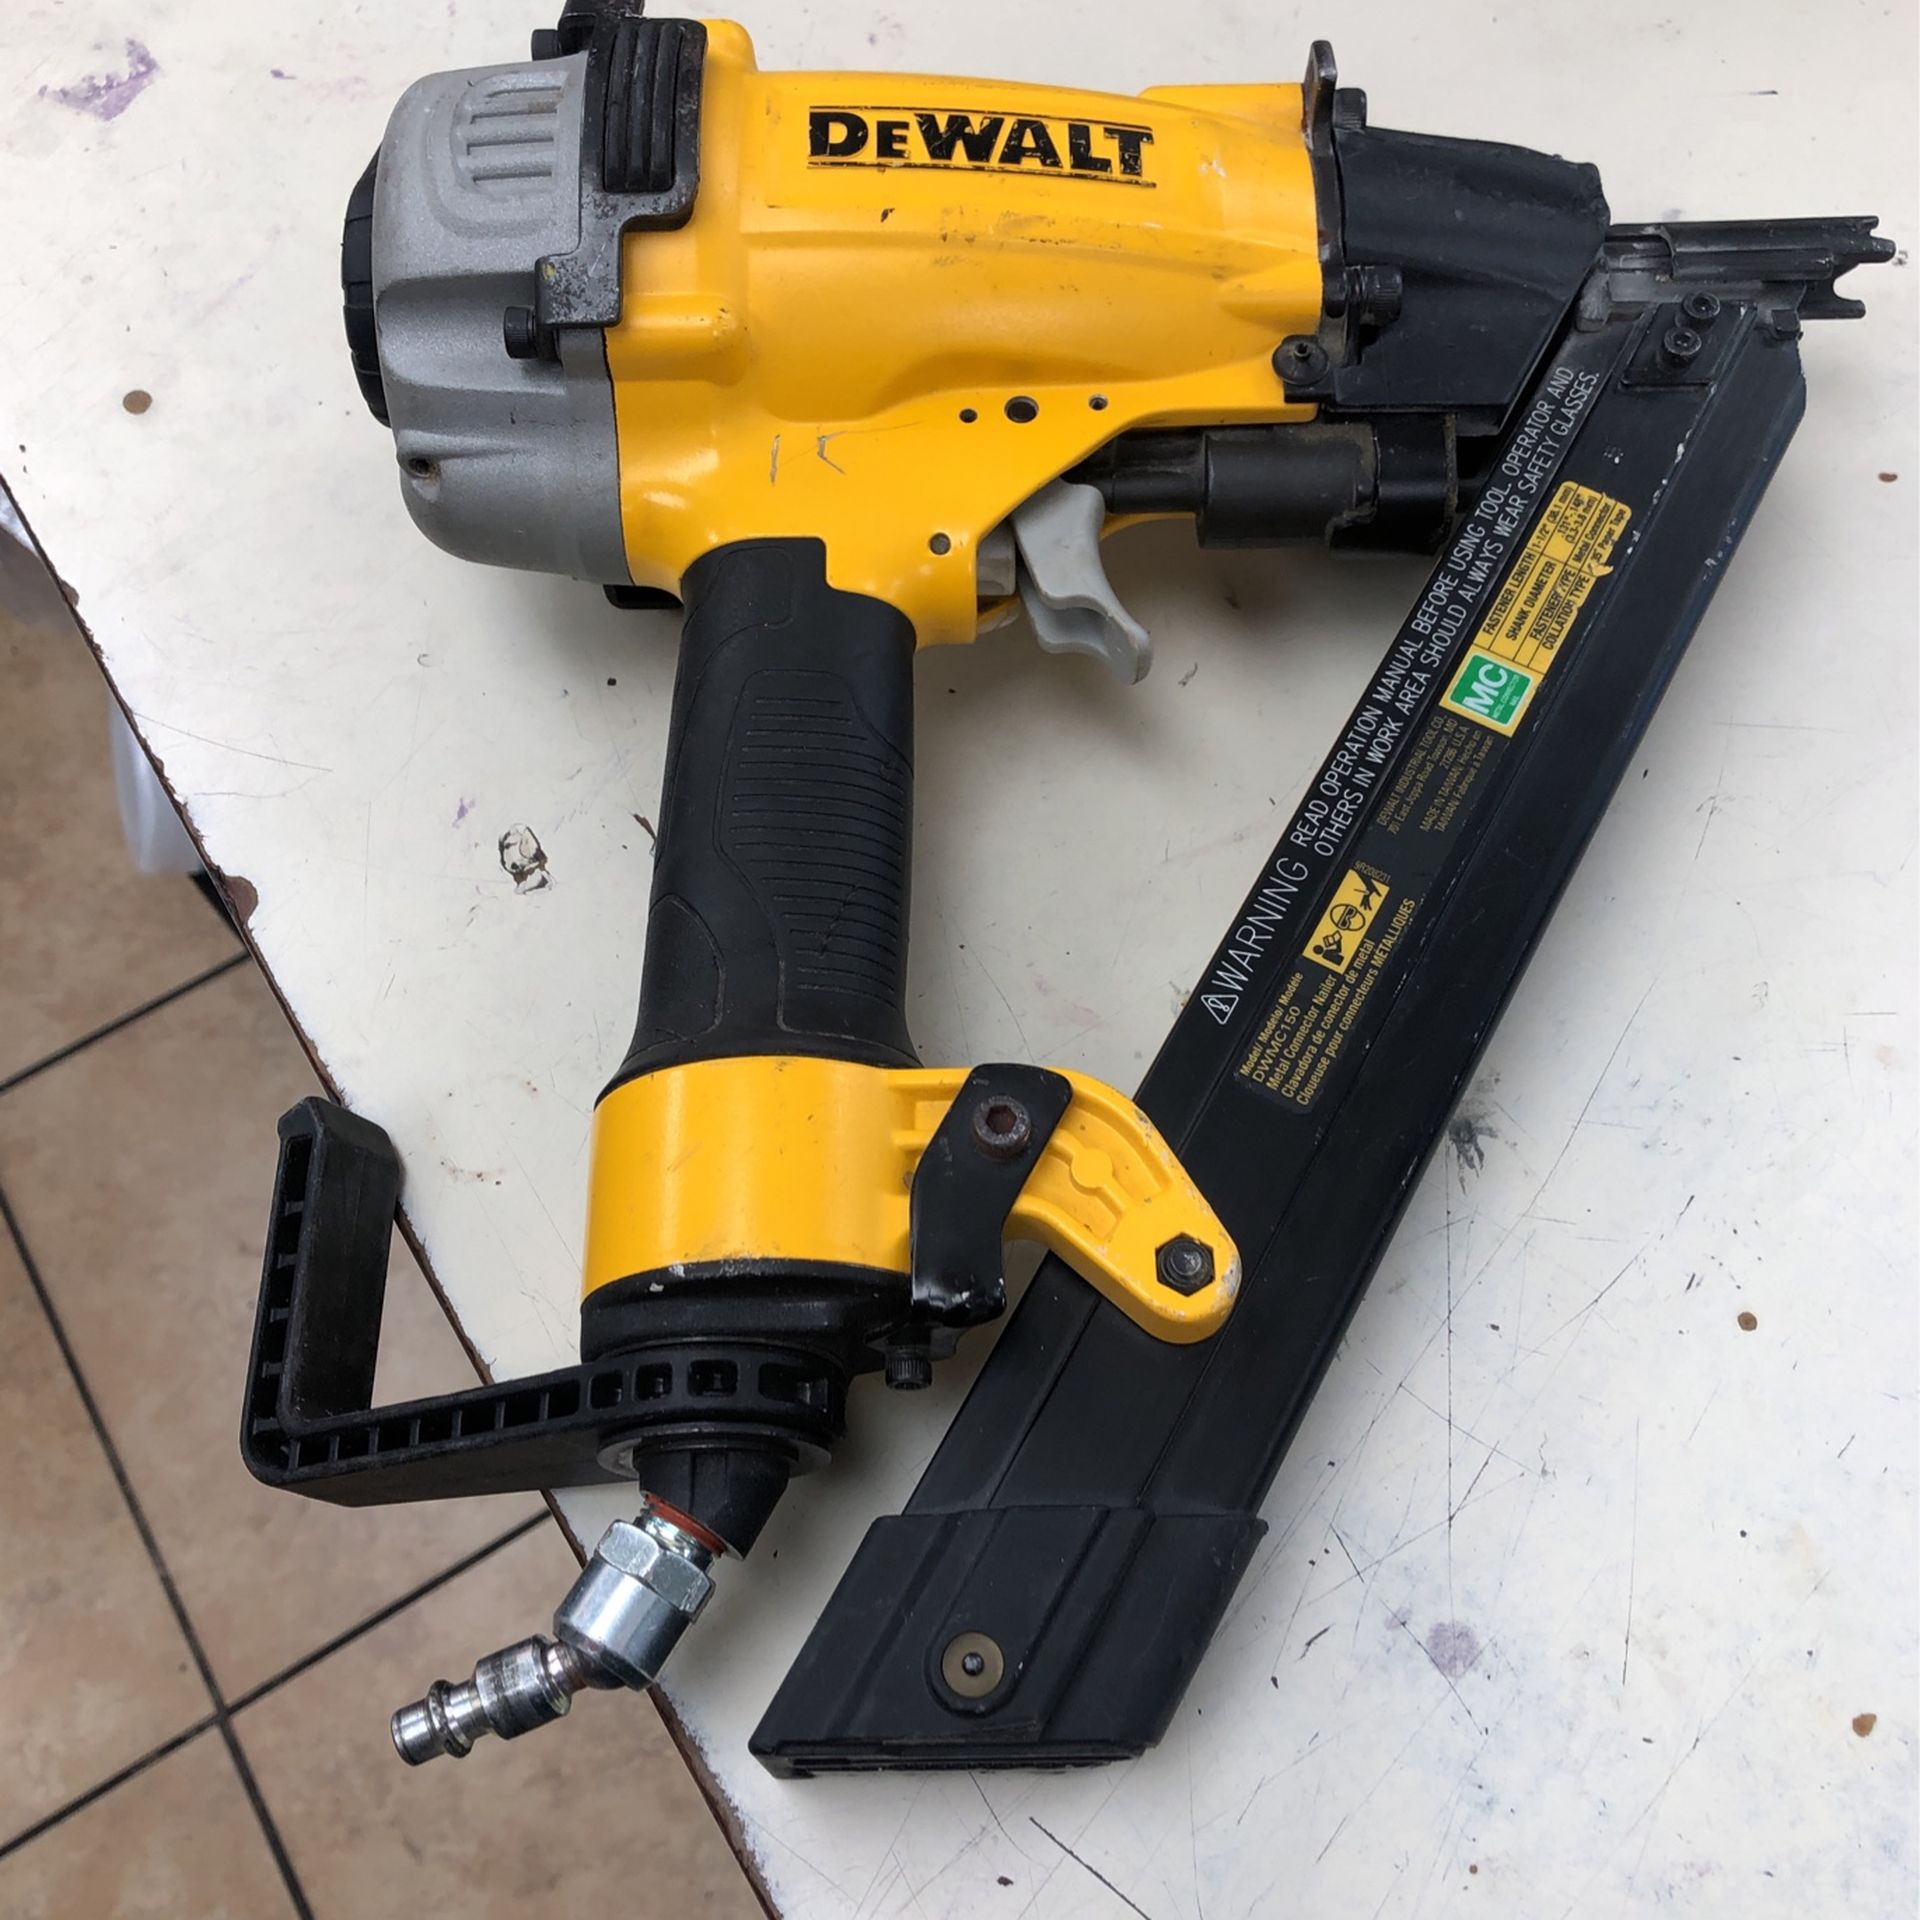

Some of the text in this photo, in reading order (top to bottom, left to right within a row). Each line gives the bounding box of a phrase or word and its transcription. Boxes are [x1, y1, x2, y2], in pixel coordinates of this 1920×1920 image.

[1583, 501, 1612, 542] Connector
[1289, 364, 1575, 848] READ OPERATION MANUAL BEFORE USING TOOL. OPERATOR AND
[1312, 367, 1600, 857] OTHERS IN WORK AREA SHOULD ALWAYS WEAR SAFETY GLASSES.
[1482, 550, 1536, 636] FASTENER LENGTH
[1504, 559, 1557, 642] SHANK DIAMETER
[1528, 588, 1563, 641] FASTENER
[1568, 573, 1590, 600] TYPE
[1460, 657, 1510, 718] MC
[1210, 854, 1310, 997] WARNING
[1250, 1003, 1302, 1083] DWMC150
[1264, 971, 1339, 1091] Metal Connector Nailer
[1279, 936, 1376, 1098] Clavadora de conector de metal
[1294, 1054, 1331, 1106] Cloueuse
[1323, 1028, 1346, 1058] pour
[1336, 966, 1380, 1031] connecteurs
